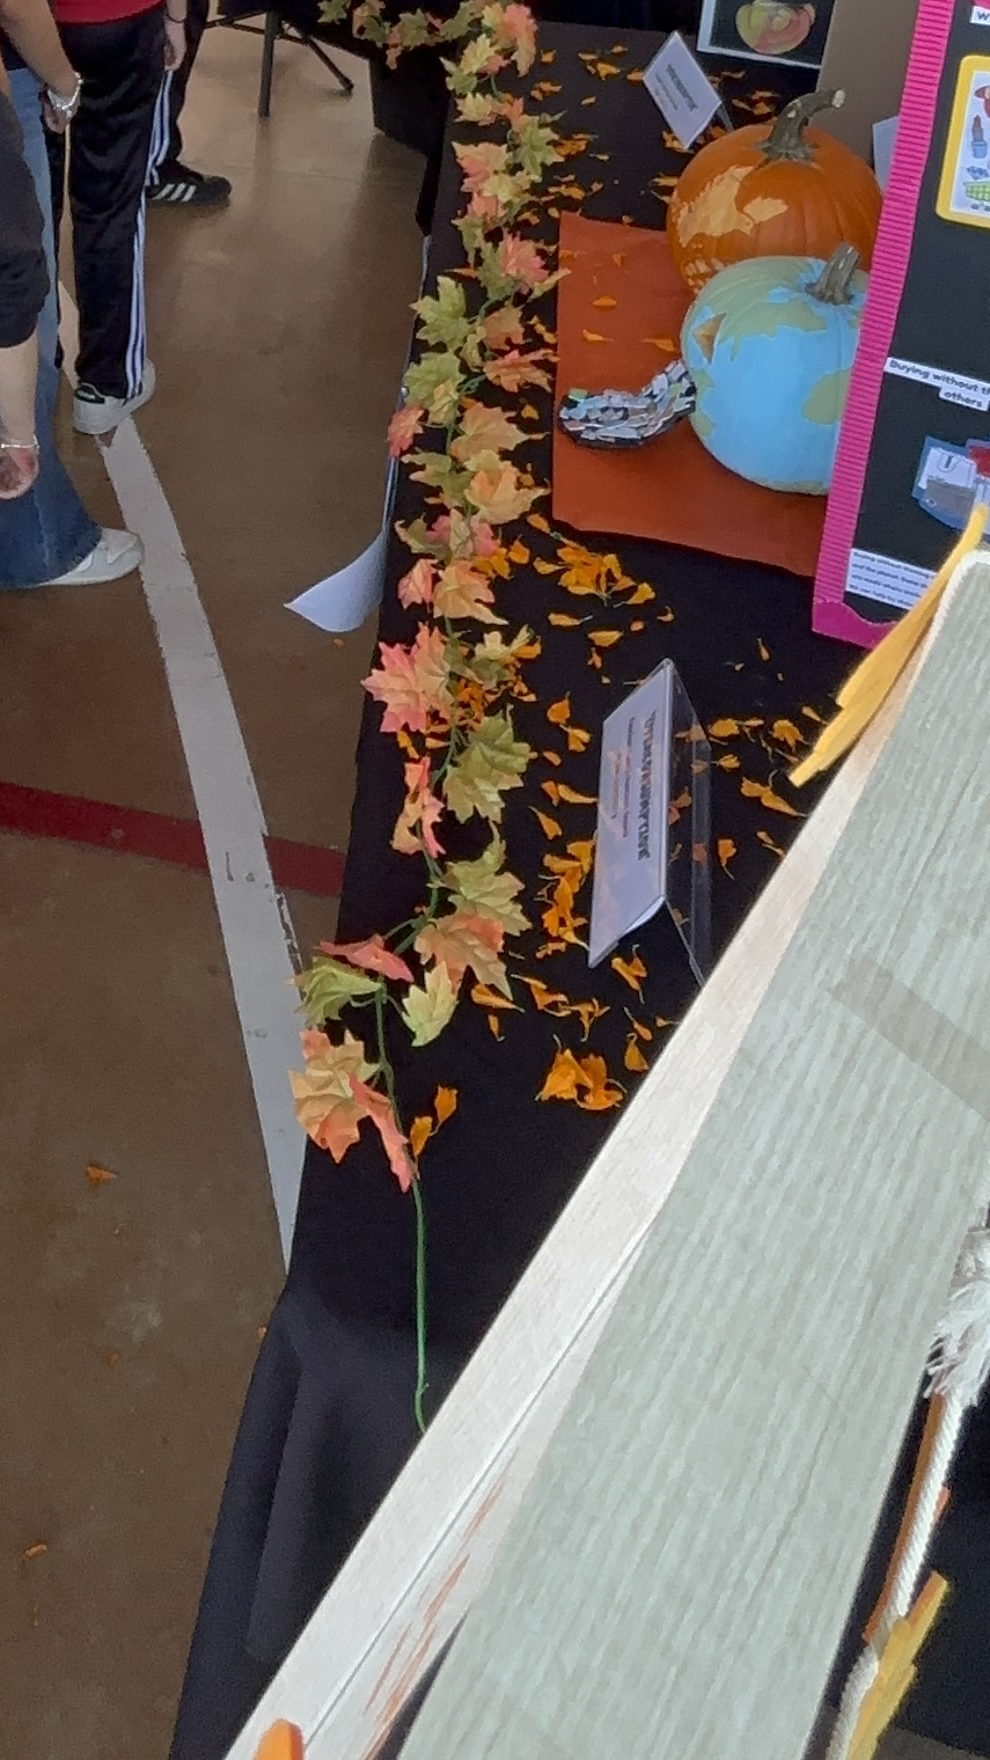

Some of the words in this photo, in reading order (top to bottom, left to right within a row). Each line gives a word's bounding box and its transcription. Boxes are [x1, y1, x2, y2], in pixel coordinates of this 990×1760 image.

[890, 359, 930, 379] Buying
[933, 373, 978, 392] without
[944, 391, 983, 408] others
